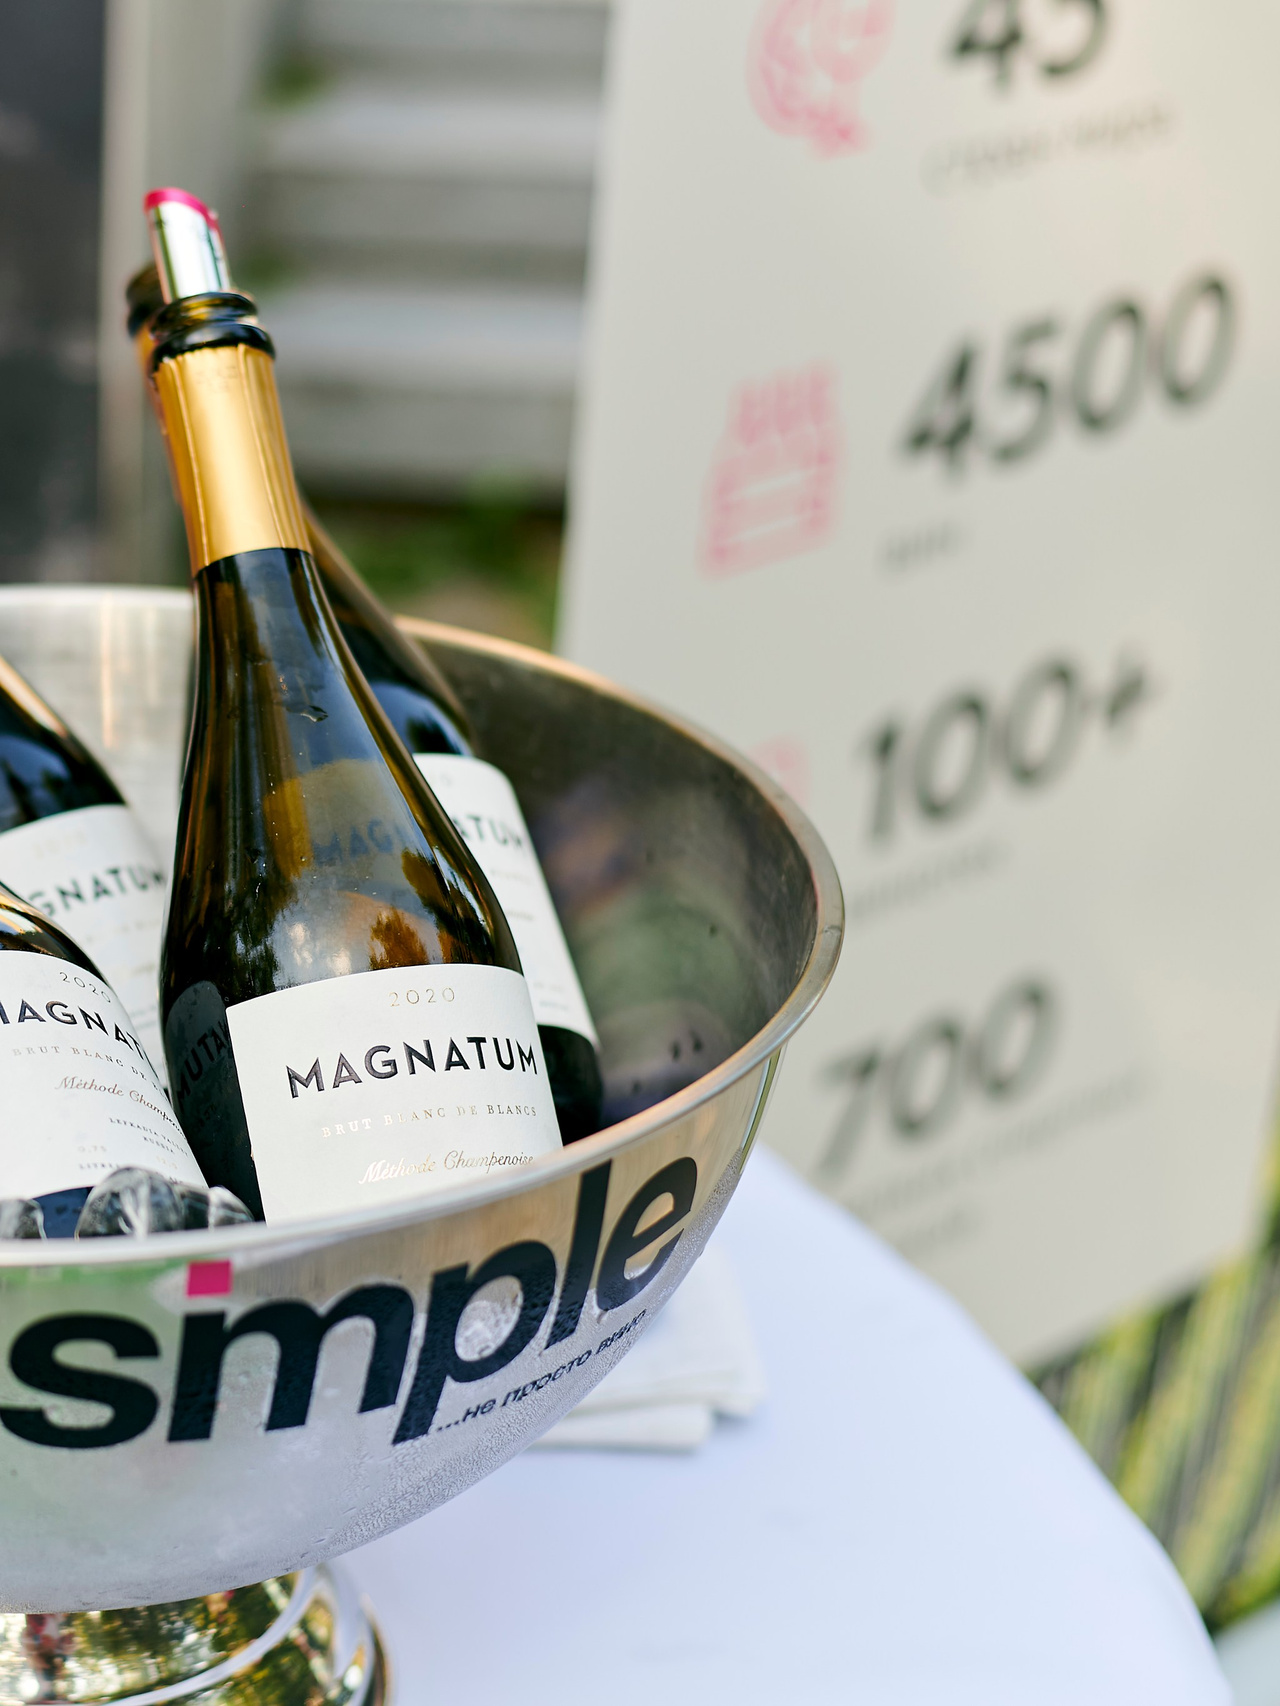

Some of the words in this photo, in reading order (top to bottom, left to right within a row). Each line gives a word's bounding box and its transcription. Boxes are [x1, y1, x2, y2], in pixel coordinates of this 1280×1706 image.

[898, 264, 1240, 486] 4500
[59, 971, 112, 1004] 2020
[388, 986, 456, 1008] 2020
[12, 1045, 60, 1057] BRUT
[71, 1046, 124, 1067] BLANC
[285, 1036, 539, 1099] MAGNATUM
[55, 1076, 125, 1097] Méthode
[818, 974, 1060, 1180] 700
[321, 1118, 373, 1138] BRUT
[384, 1106, 446, 1127] BLANC
[456, 1104, 478, 1116] DE
[487, 1103, 537, 1117] BLANCS
[358, 1153, 436, 1185] Méthode
[443, 1149, 535, 1174] Champenoise
[501, 1350, 592, 1407] просто
